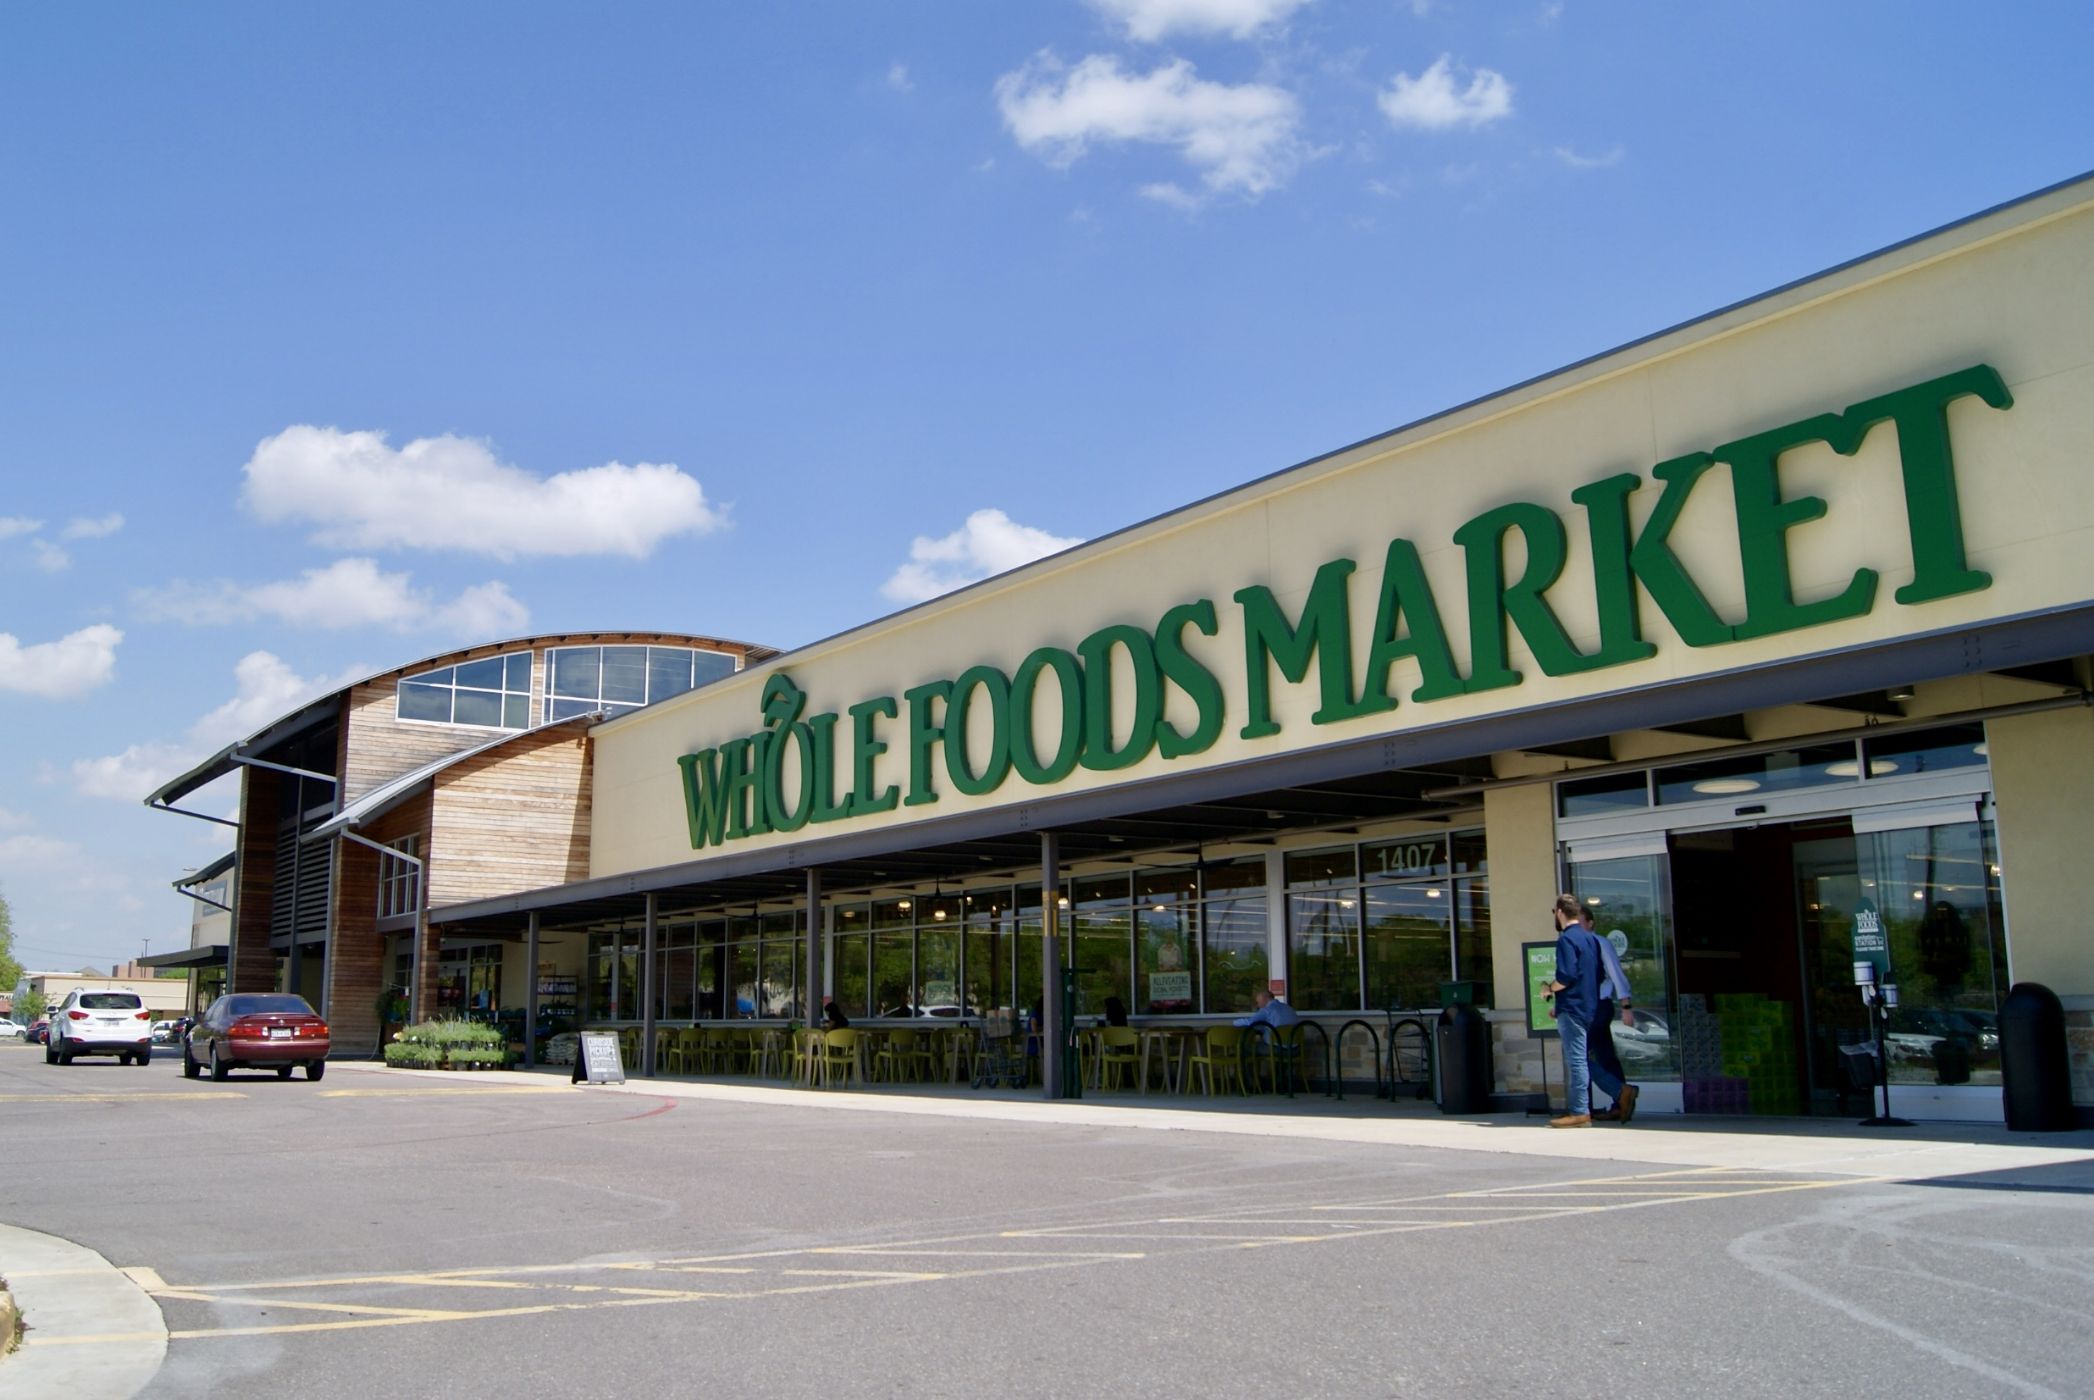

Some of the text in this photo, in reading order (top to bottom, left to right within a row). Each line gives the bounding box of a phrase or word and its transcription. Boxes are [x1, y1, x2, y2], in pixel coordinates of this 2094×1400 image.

[677, 363, 2014, 850] WHOLE FOODS MARKET
[1377, 843, 1436, 874] 1407
